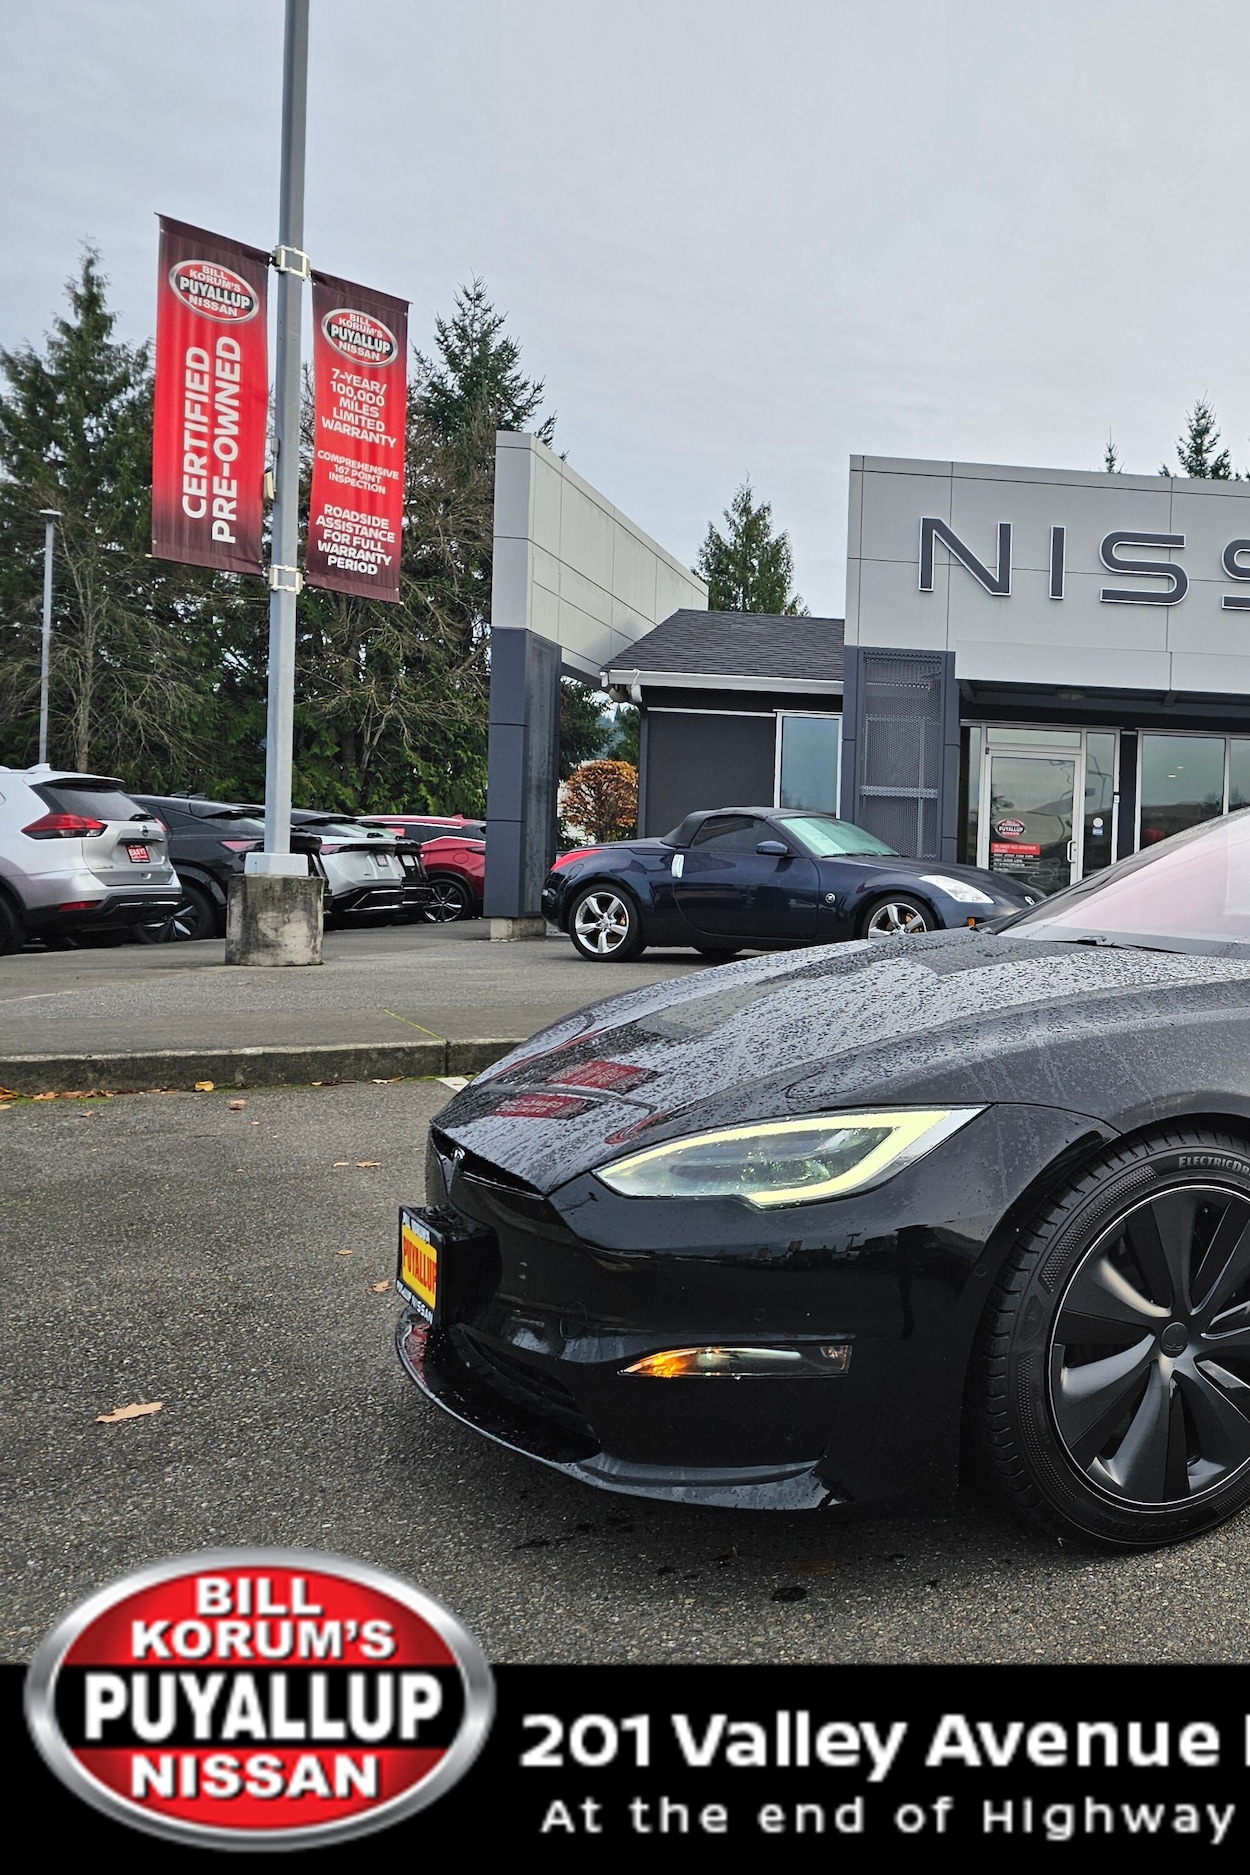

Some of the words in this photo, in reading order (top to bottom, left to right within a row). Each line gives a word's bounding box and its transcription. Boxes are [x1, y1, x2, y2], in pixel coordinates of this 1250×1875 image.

[190, 269, 241, 292] KORUM'S
[202, 265, 228, 280] BILL
[180, 276, 251, 309] PUYALLUP
[188, 294, 238, 317] NISSAN
[338, 317, 384, 338] KORUM'S
[350, 313, 371, 327] BILL
[330, 324, 391, 354] PUYALLUP
[338, 341, 380, 362] NISSAN
[331, 367, 387, 395] 7-YEAR/
[330, 381, 385, 407] 100,000
[333, 407, 386, 432] LIMITED
[339, 396, 379, 418] MILES
[182, 346, 210, 519] CERTIFIED
[212, 336, 241, 544] PRE-OWNED
[321, 416, 397, 448] WARRANTY
[317, 450, 400, 480] COMPREHENSIVE
[334, 464, 350, 475] 167
[351, 470, 382, 484] POINT
[328, 471, 387, 495] INSPECTION
[315, 515, 396, 543] ASSISTANCE
[323, 503, 390, 530] ROADSIDE
[317, 540, 393, 566] WARRANTY
[323, 528, 350, 546] FOR
[352, 535, 385, 553] FULL
[327, 555, 378, 576] PERIOD
